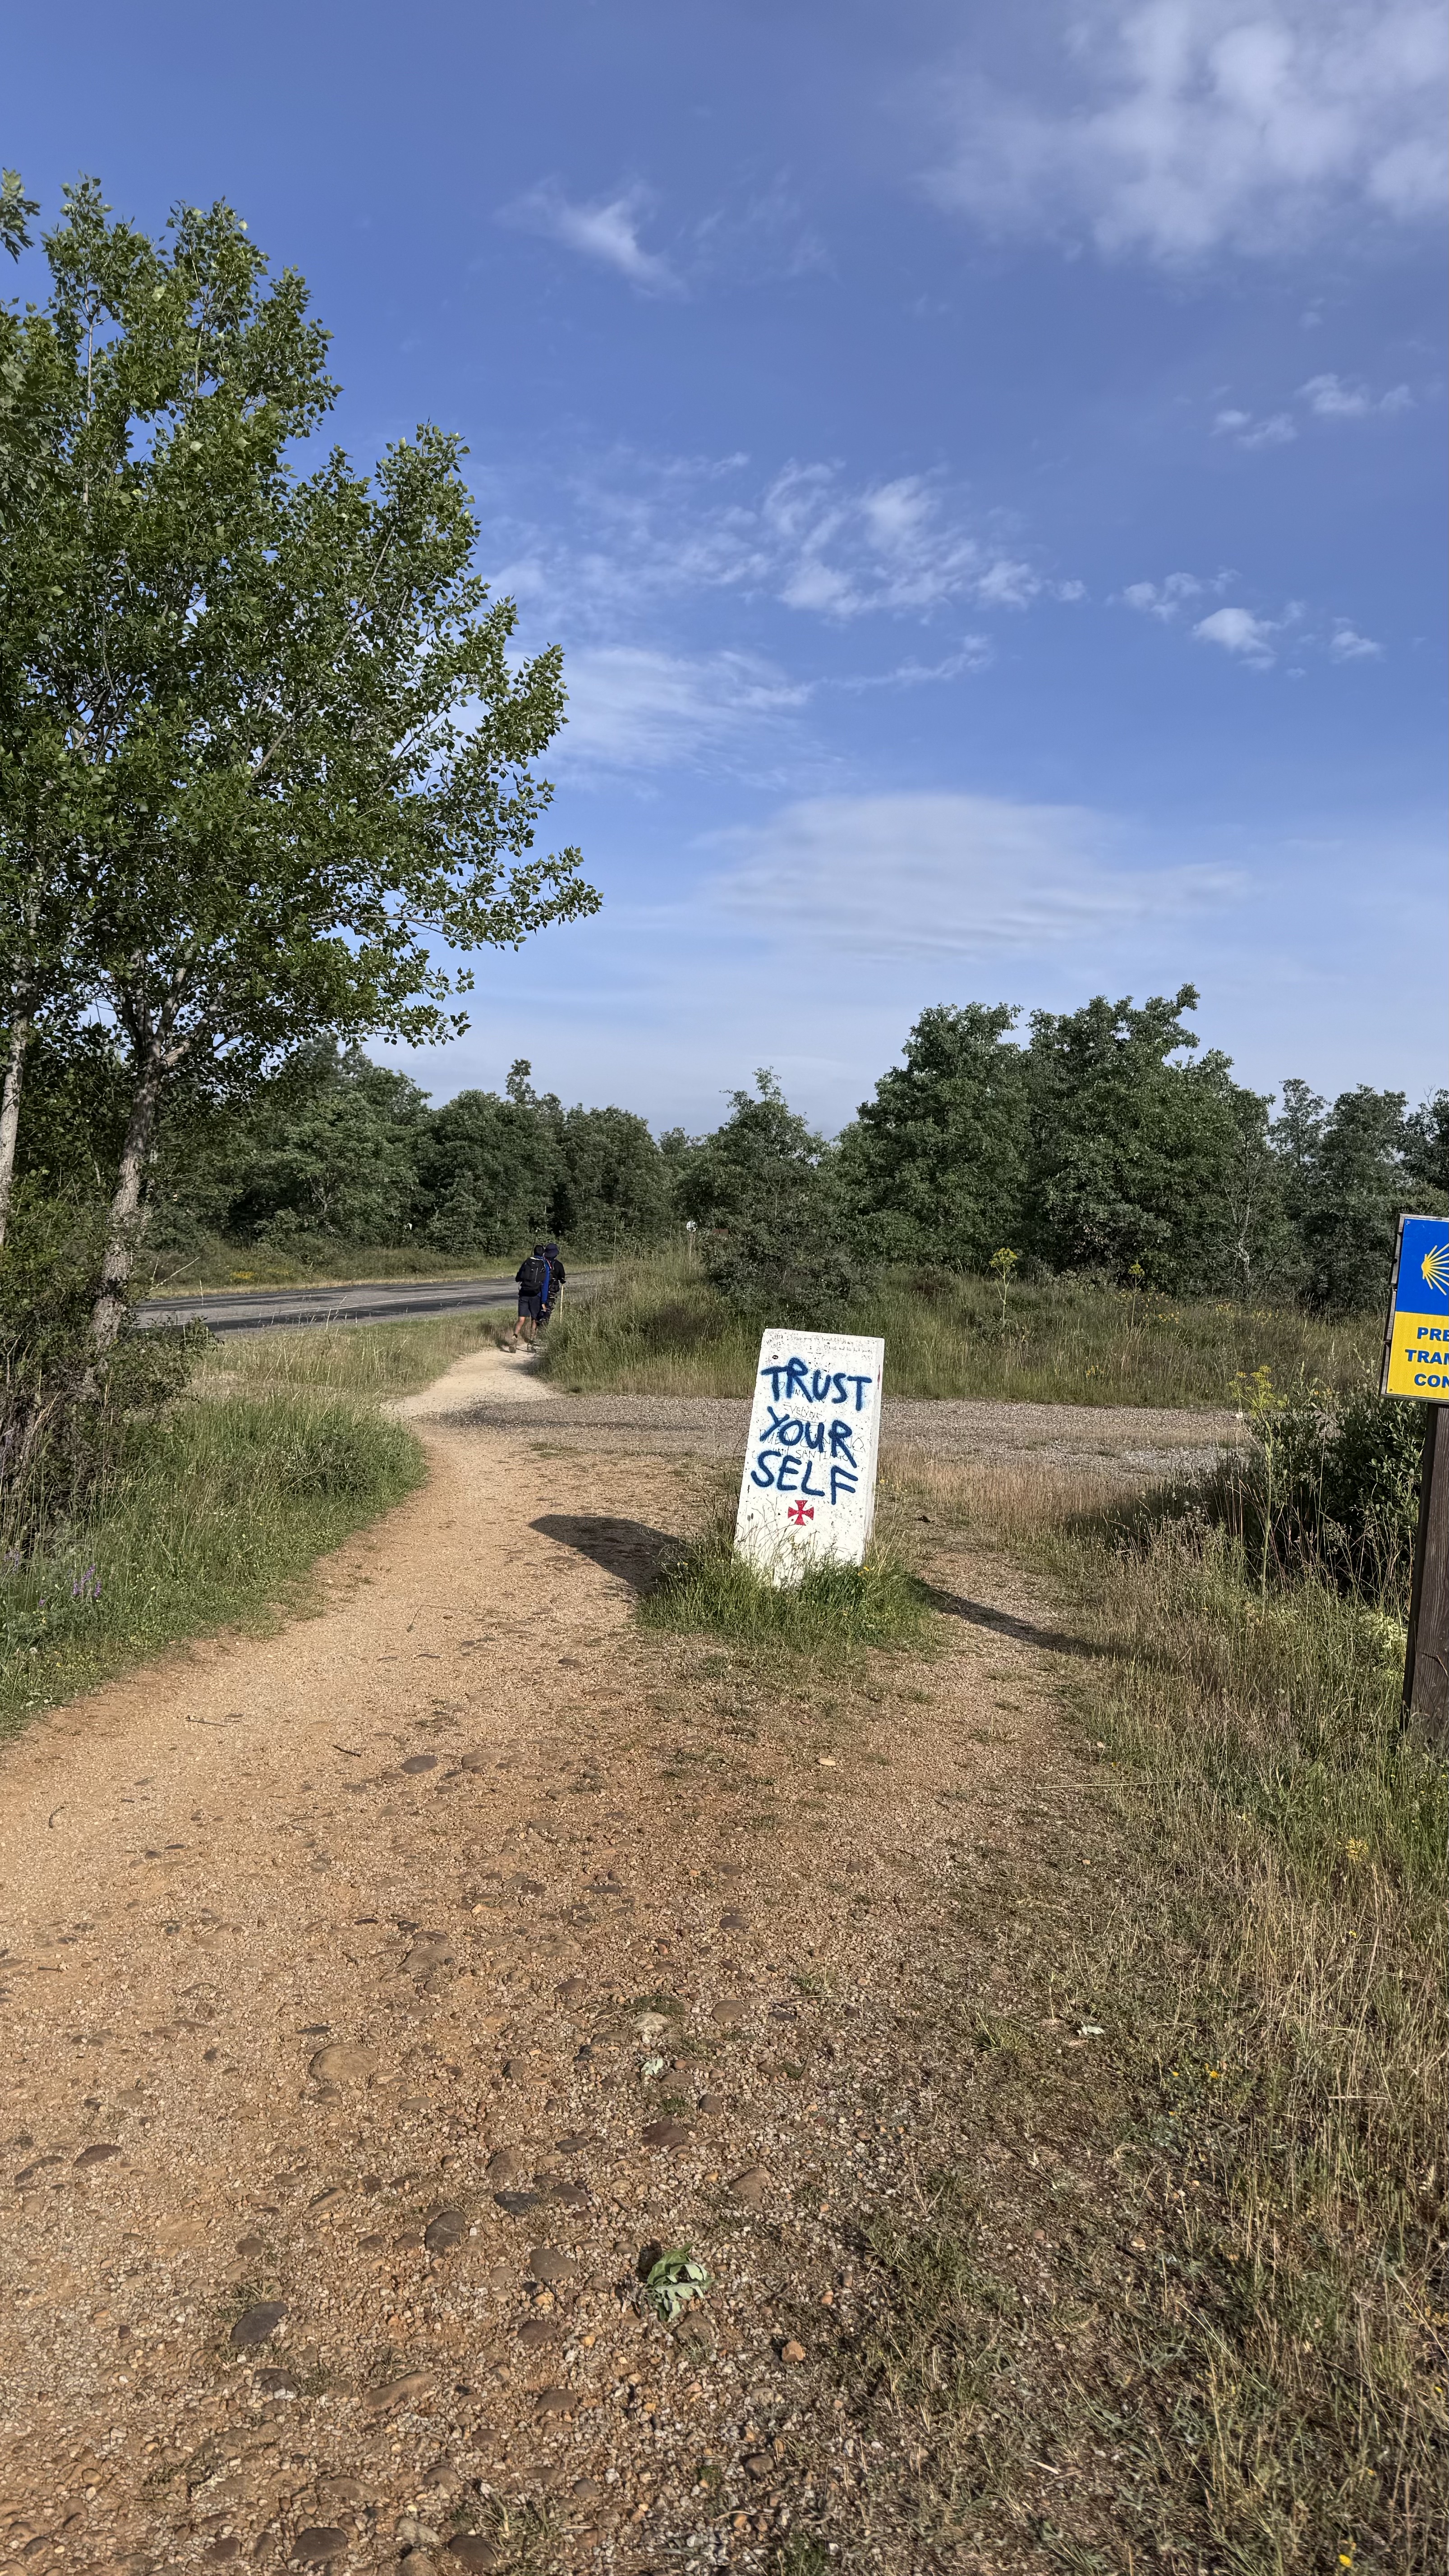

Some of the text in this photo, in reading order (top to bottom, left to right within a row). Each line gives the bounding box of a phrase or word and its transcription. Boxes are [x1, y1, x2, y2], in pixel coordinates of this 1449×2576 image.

[761, 1357, 873, 1411] TRUST
[760, 1406, 857, 1467] YOUR
[751, 1450, 858, 1504] SELF
